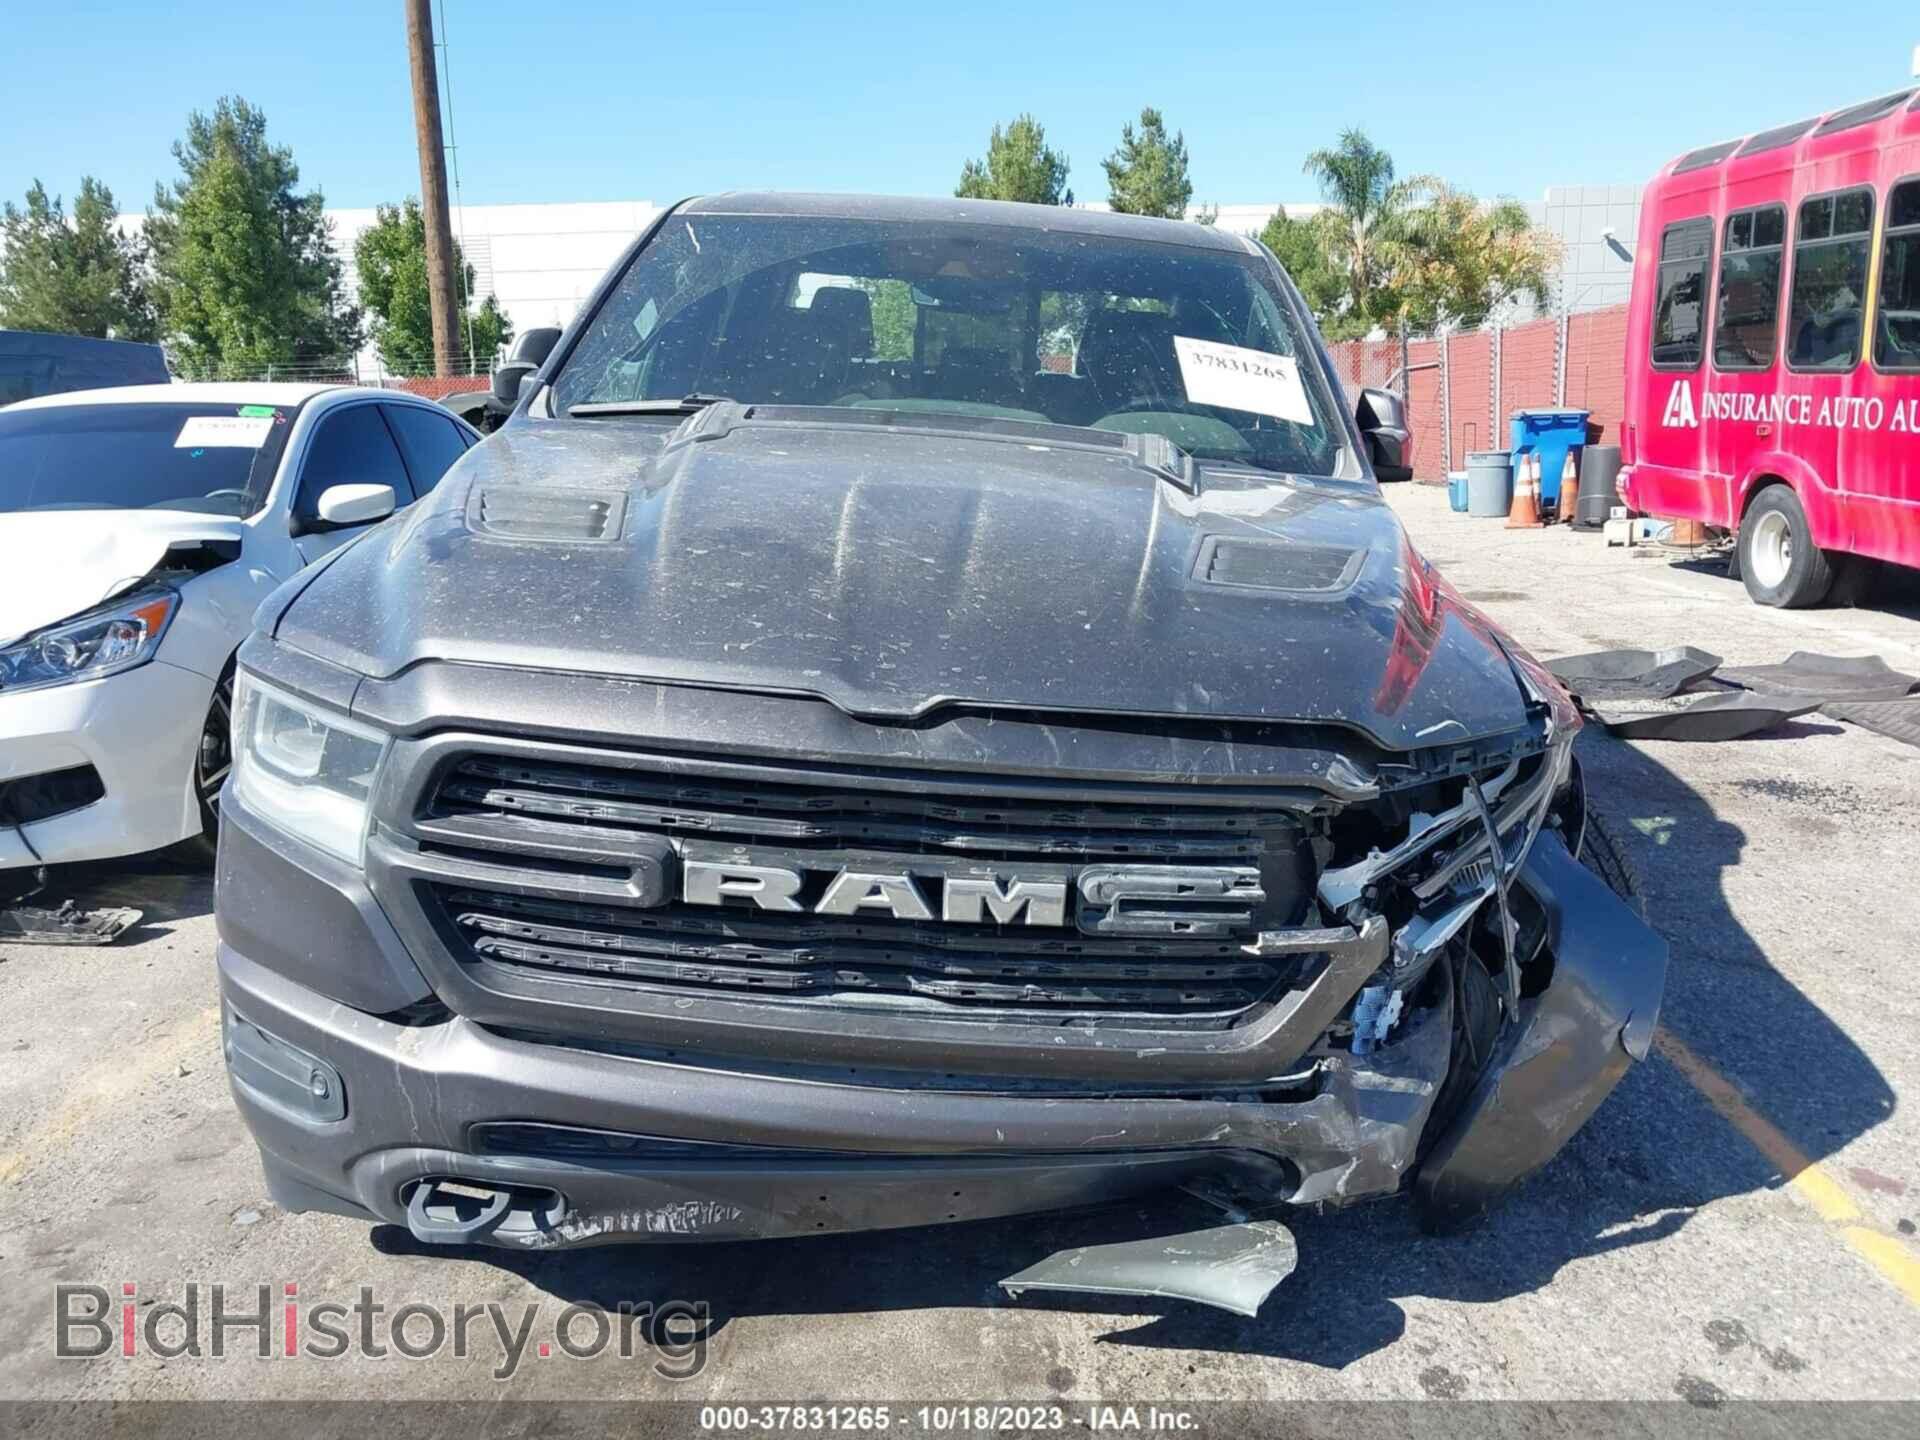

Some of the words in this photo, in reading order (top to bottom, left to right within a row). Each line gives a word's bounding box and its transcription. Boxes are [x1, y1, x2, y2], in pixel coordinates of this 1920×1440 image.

[1192, 352, 1287, 380] 37831265
[1702, 393, 1812, 425] INSURANCE
[1817, 397, 1884, 430] AUTO
[683, 859, 1069, 927] RAM
